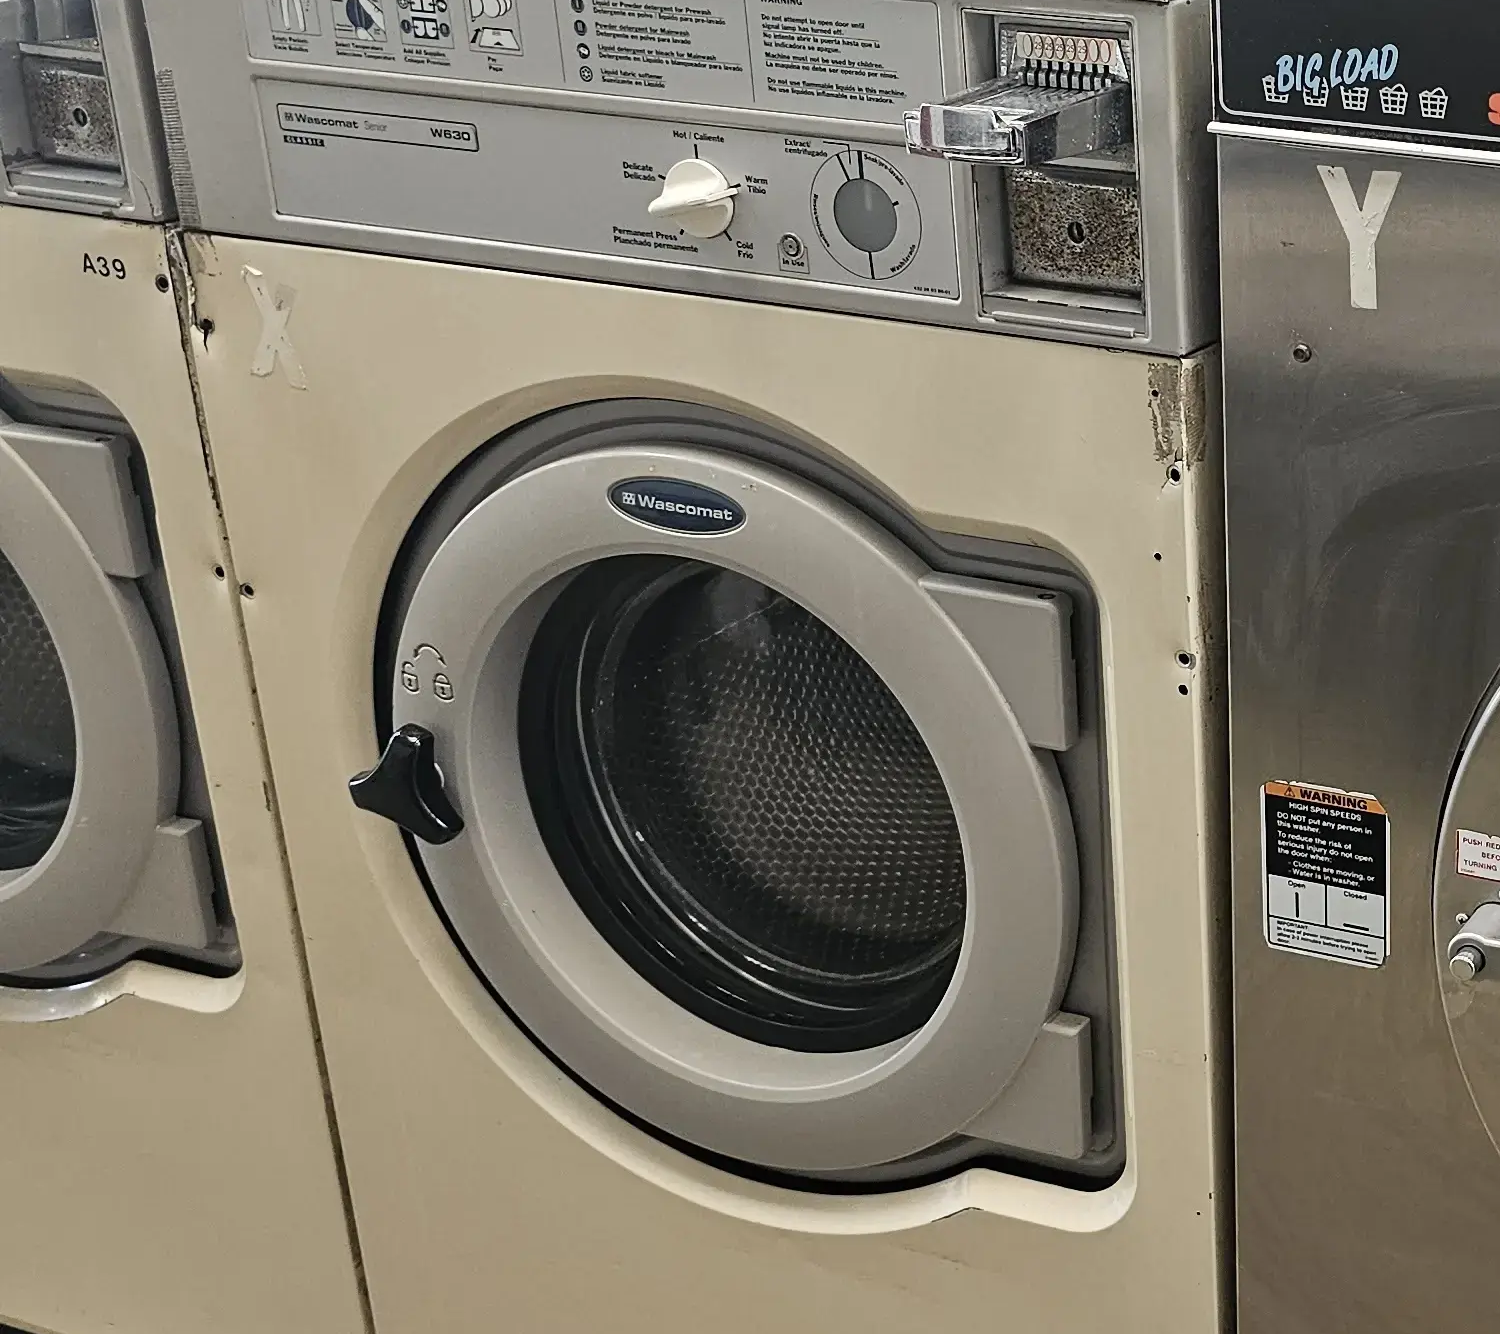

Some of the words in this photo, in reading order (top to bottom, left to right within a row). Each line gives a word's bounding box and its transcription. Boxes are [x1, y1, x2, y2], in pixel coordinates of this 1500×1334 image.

[1276, 53, 1322, 96] BIG
[1330, 44, 1399, 88] LOAD
[295, 112, 359, 129] Wascomat
[364, 121, 388, 132] Senior
[430, 127, 471, 141] W630
[673, 131, 686, 139] Hot
[694, 132, 725, 143] Caliente
[623, 161, 653, 172] Delicate
[624, 171, 656, 182] Delicado
[745, 175, 768, 185] Warm
[747, 185, 766, 194] Tibio
[613, 226, 654, 238] Permanent
[656, 231, 678, 241] Press
[1316, 164, 1403, 310] Y
[614, 236, 652, 248] Planchado
[654, 240, 698, 253] permanente
[736, 241, 753, 250] Cold
[737, 250, 753, 259] Frio
[82, 253, 128, 280] A39
[638, 494, 732, 520] Wascomat
[1300, 789, 1368, 810] WARNING
[1289, 802, 1308, 813] HIGH
[1310, 806, 1329, 816] SPIN
[1330, 809, 1362, 822] SPEEDS
[1277, 811, 1289, 819] DO
[1290, 813, 1307, 823] NOT
[1308, 817, 1321, 827] put
[1322, 820, 1335, 830] any
[1336, 823, 1363, 833] person
[1364, 827, 1372, 835] in
[1277, 820, 1291, 828] this
[1293, 823, 1321, 834] washer.
[1462, 837, 1483, 847] PUSH
[1486, 842, 1500, 850] RED
[1463, 859, 1497, 871] TURNING
[1288, 880, 1306, 889] Open
[1344, 891, 1368, 901] Closed
